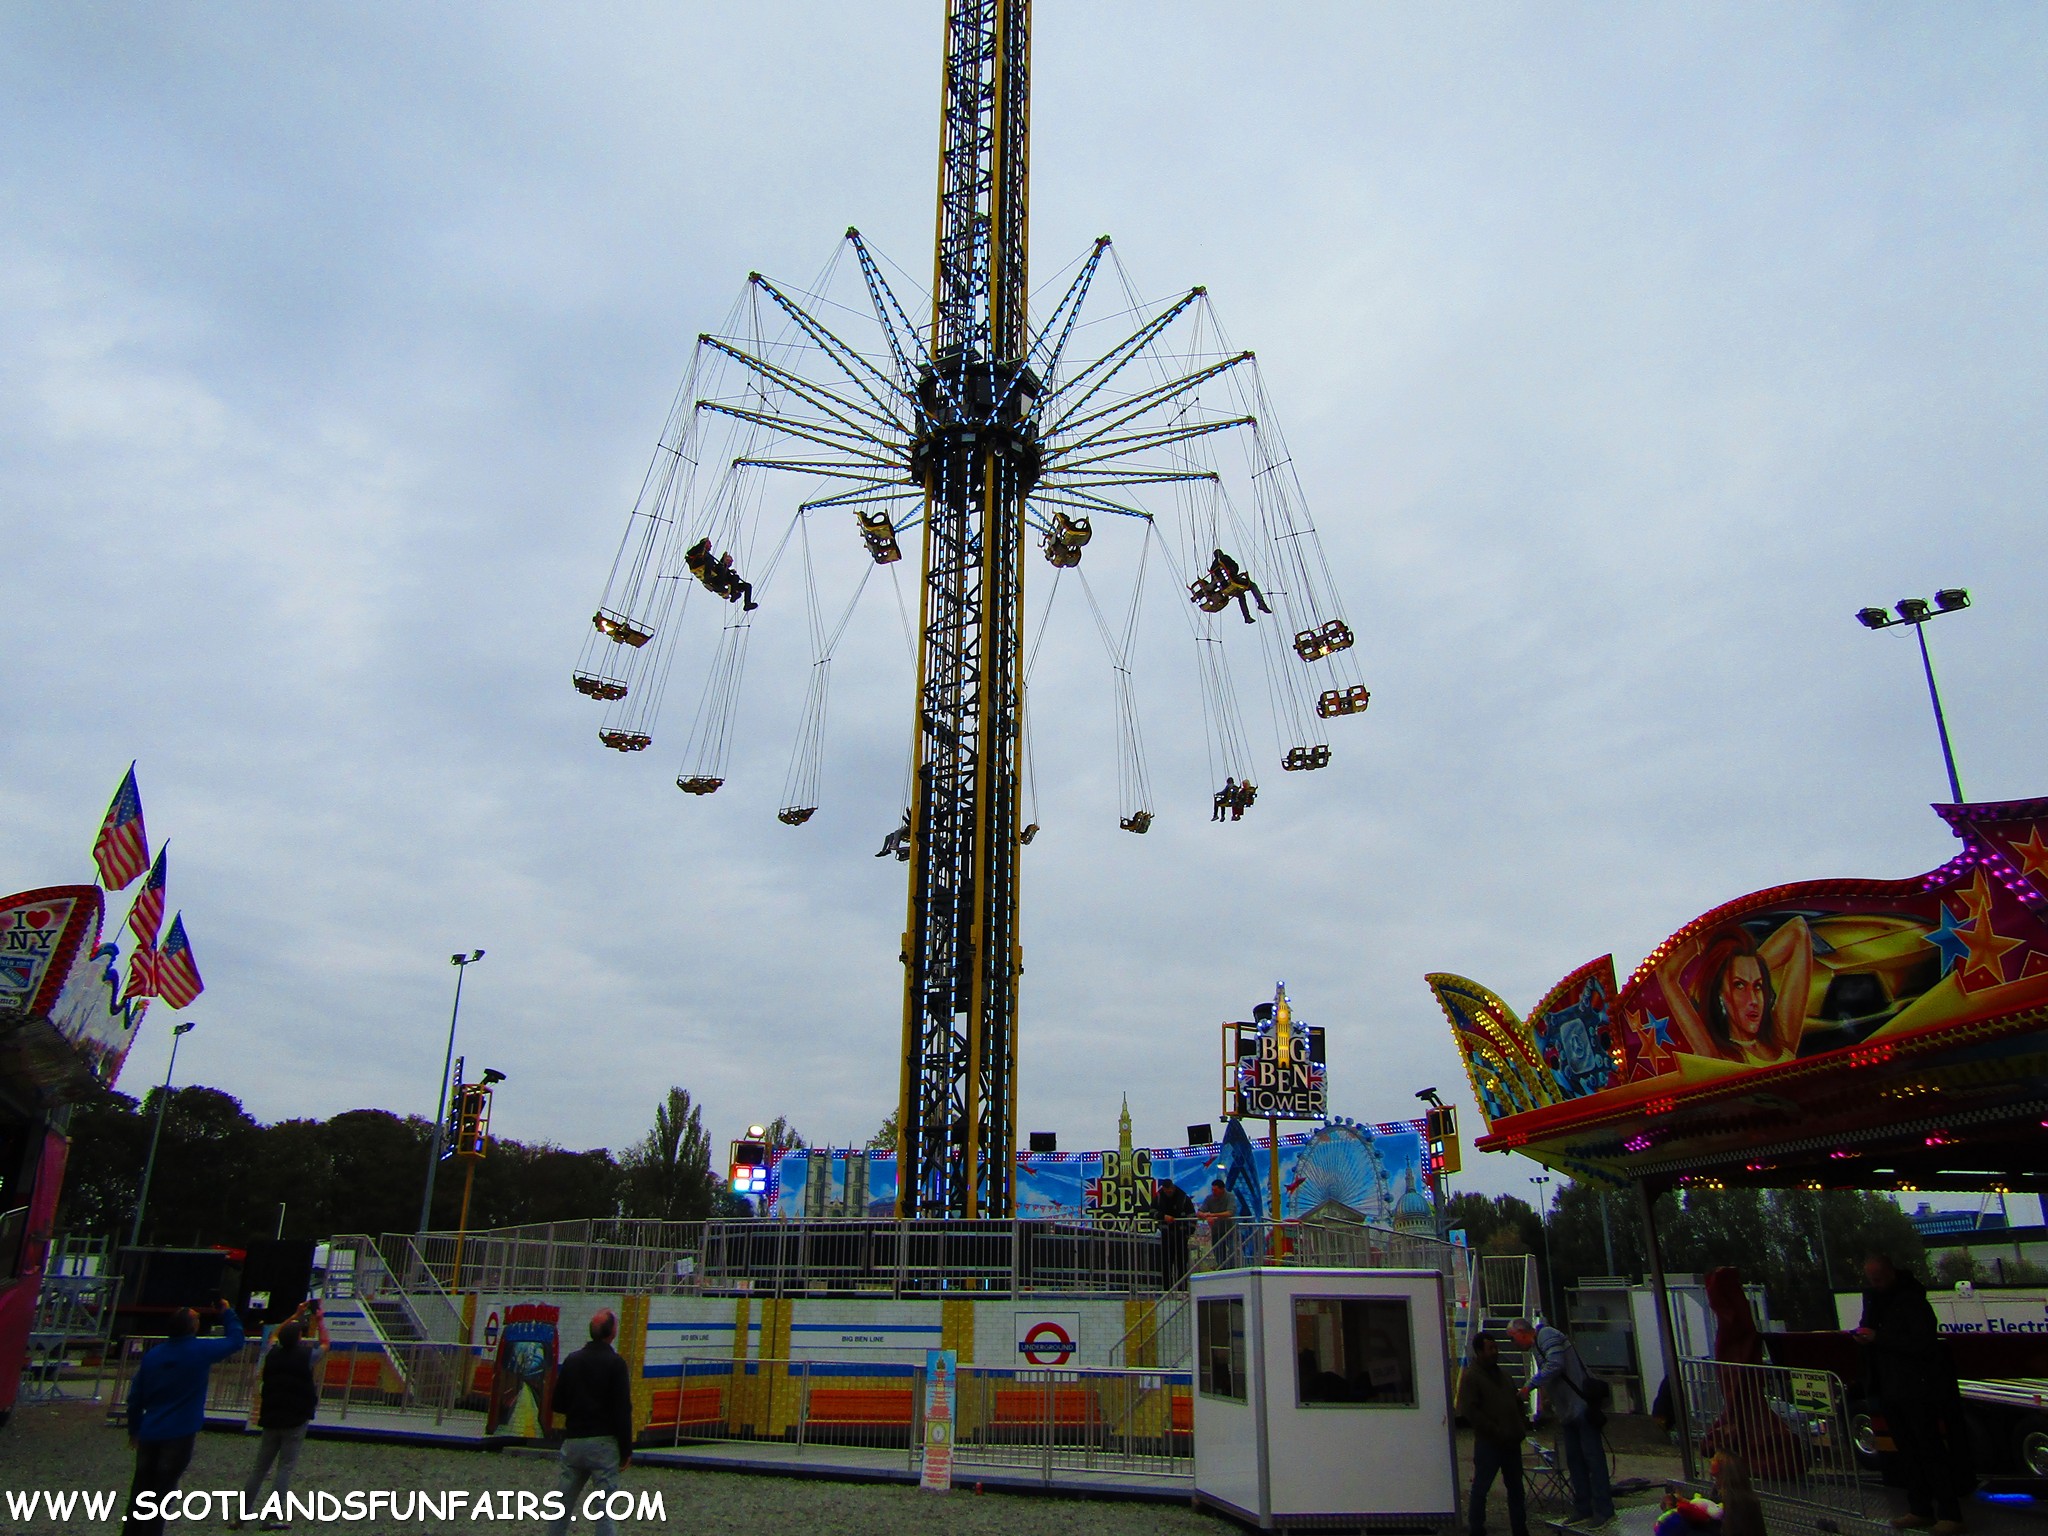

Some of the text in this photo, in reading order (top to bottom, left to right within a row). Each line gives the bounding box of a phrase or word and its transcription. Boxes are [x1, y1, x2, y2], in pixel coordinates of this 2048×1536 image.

[13, 910, 26, 929] I
[6, 930, 57, 949] NY
[1260, 1062, 1308, 1094] BEN
[1246, 1087, 1324, 1112] TOWER
[1100, 1179, 1153, 1214] BEN
[1938, 1323, 1983, 1332] ower
[841, 1335, 854, 1343] BIG
[854, 1335, 869, 1343] BEN
